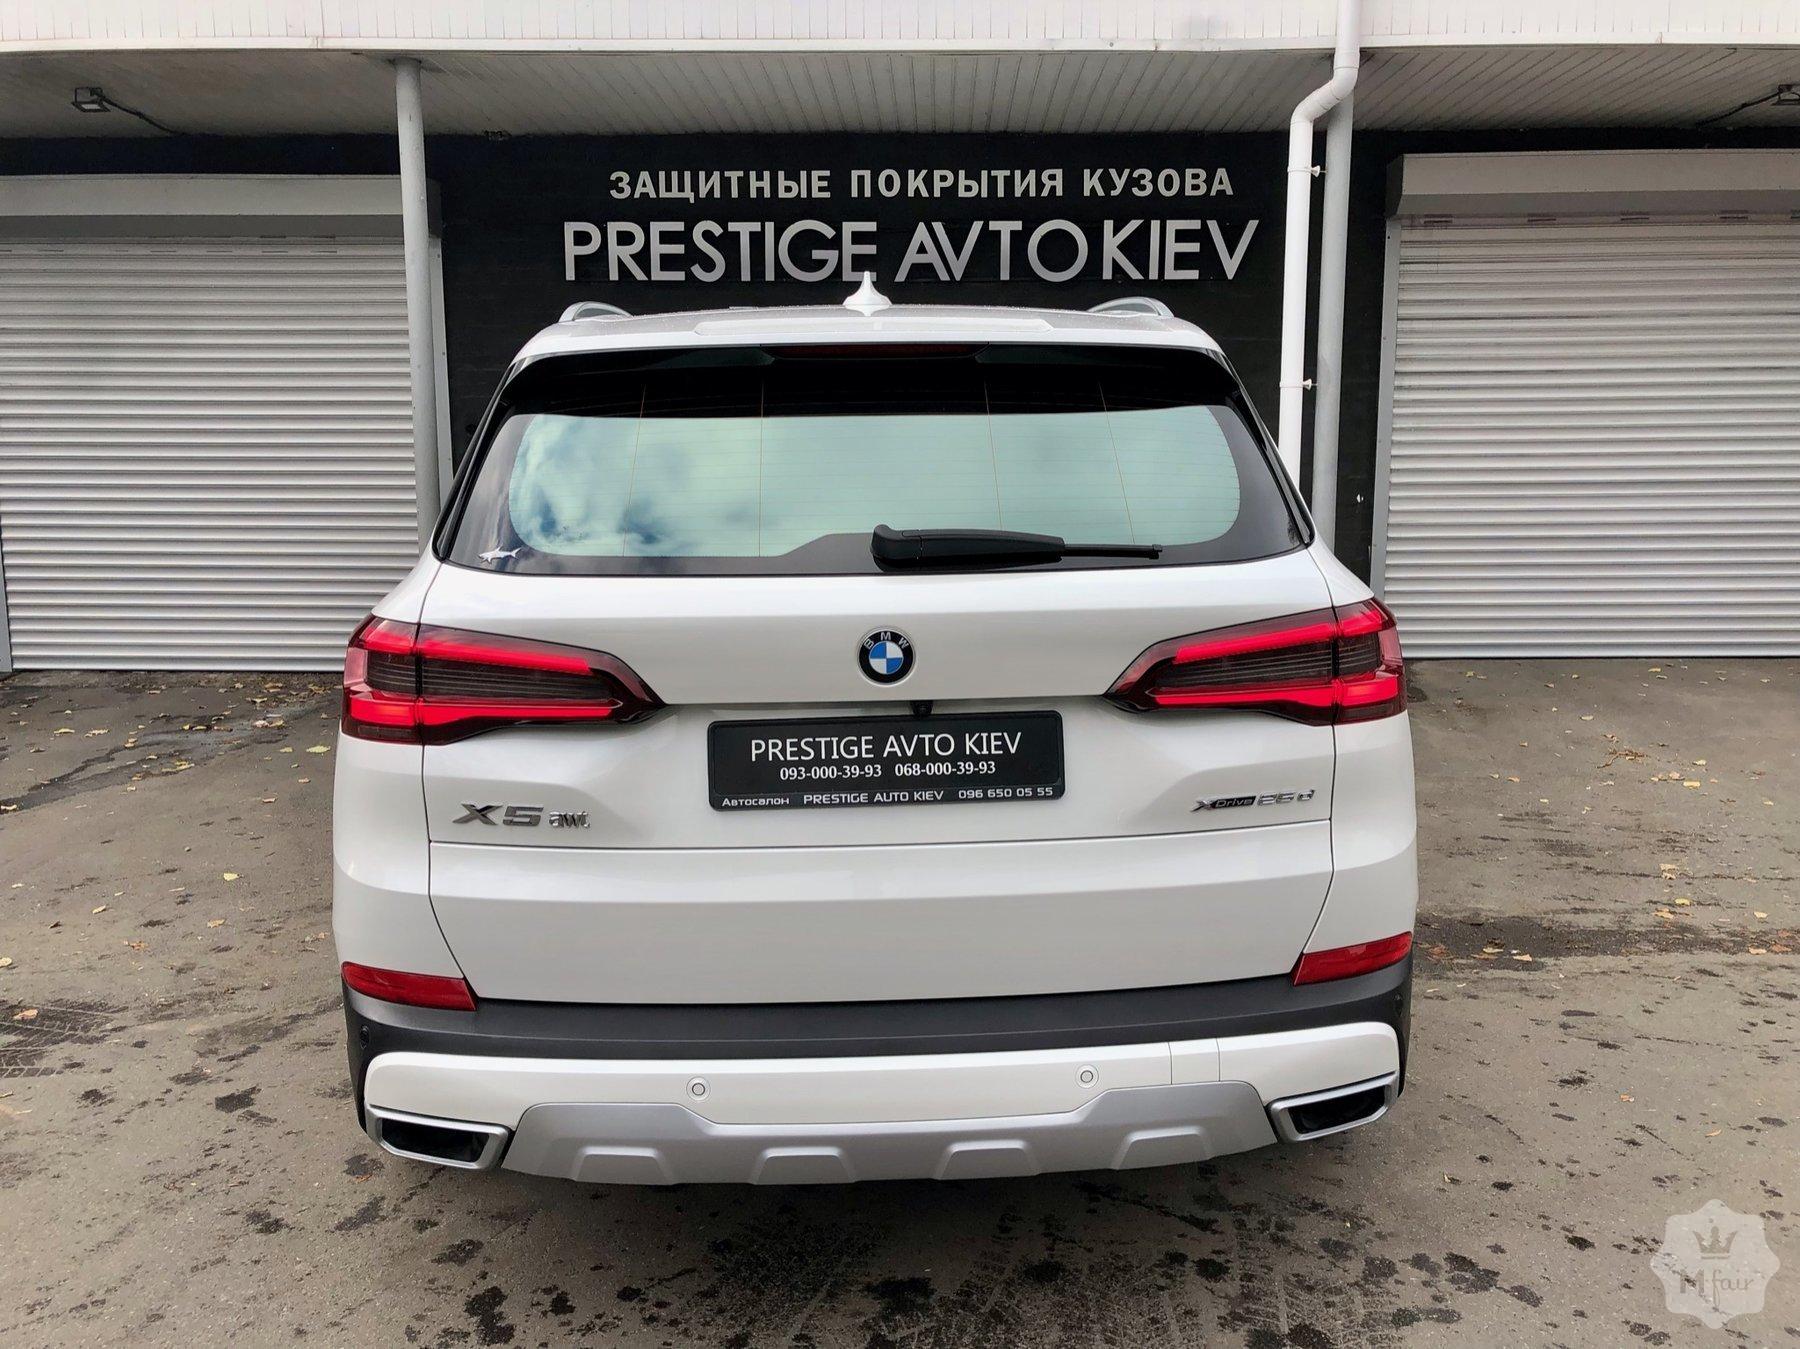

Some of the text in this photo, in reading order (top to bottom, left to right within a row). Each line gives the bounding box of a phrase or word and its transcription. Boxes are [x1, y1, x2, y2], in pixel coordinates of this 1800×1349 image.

[609, 168, 1234, 204] ЗАЩИТНЫЕ ПОКРЫТИЯ КУЗОВА
[563, 219, 1260, 282] PRESTIGE AVTO KIEV
[864, 631, 910, 650] BMW
[751, 732, 1022, 761] PRESTIGE AVTO KIEV
[780, 761, 996, 781] 093-000-39-93 068-000-39-93
[803, 786, 1054, 805] PRESTIGE AUTO KIEV 096 650 05 55
